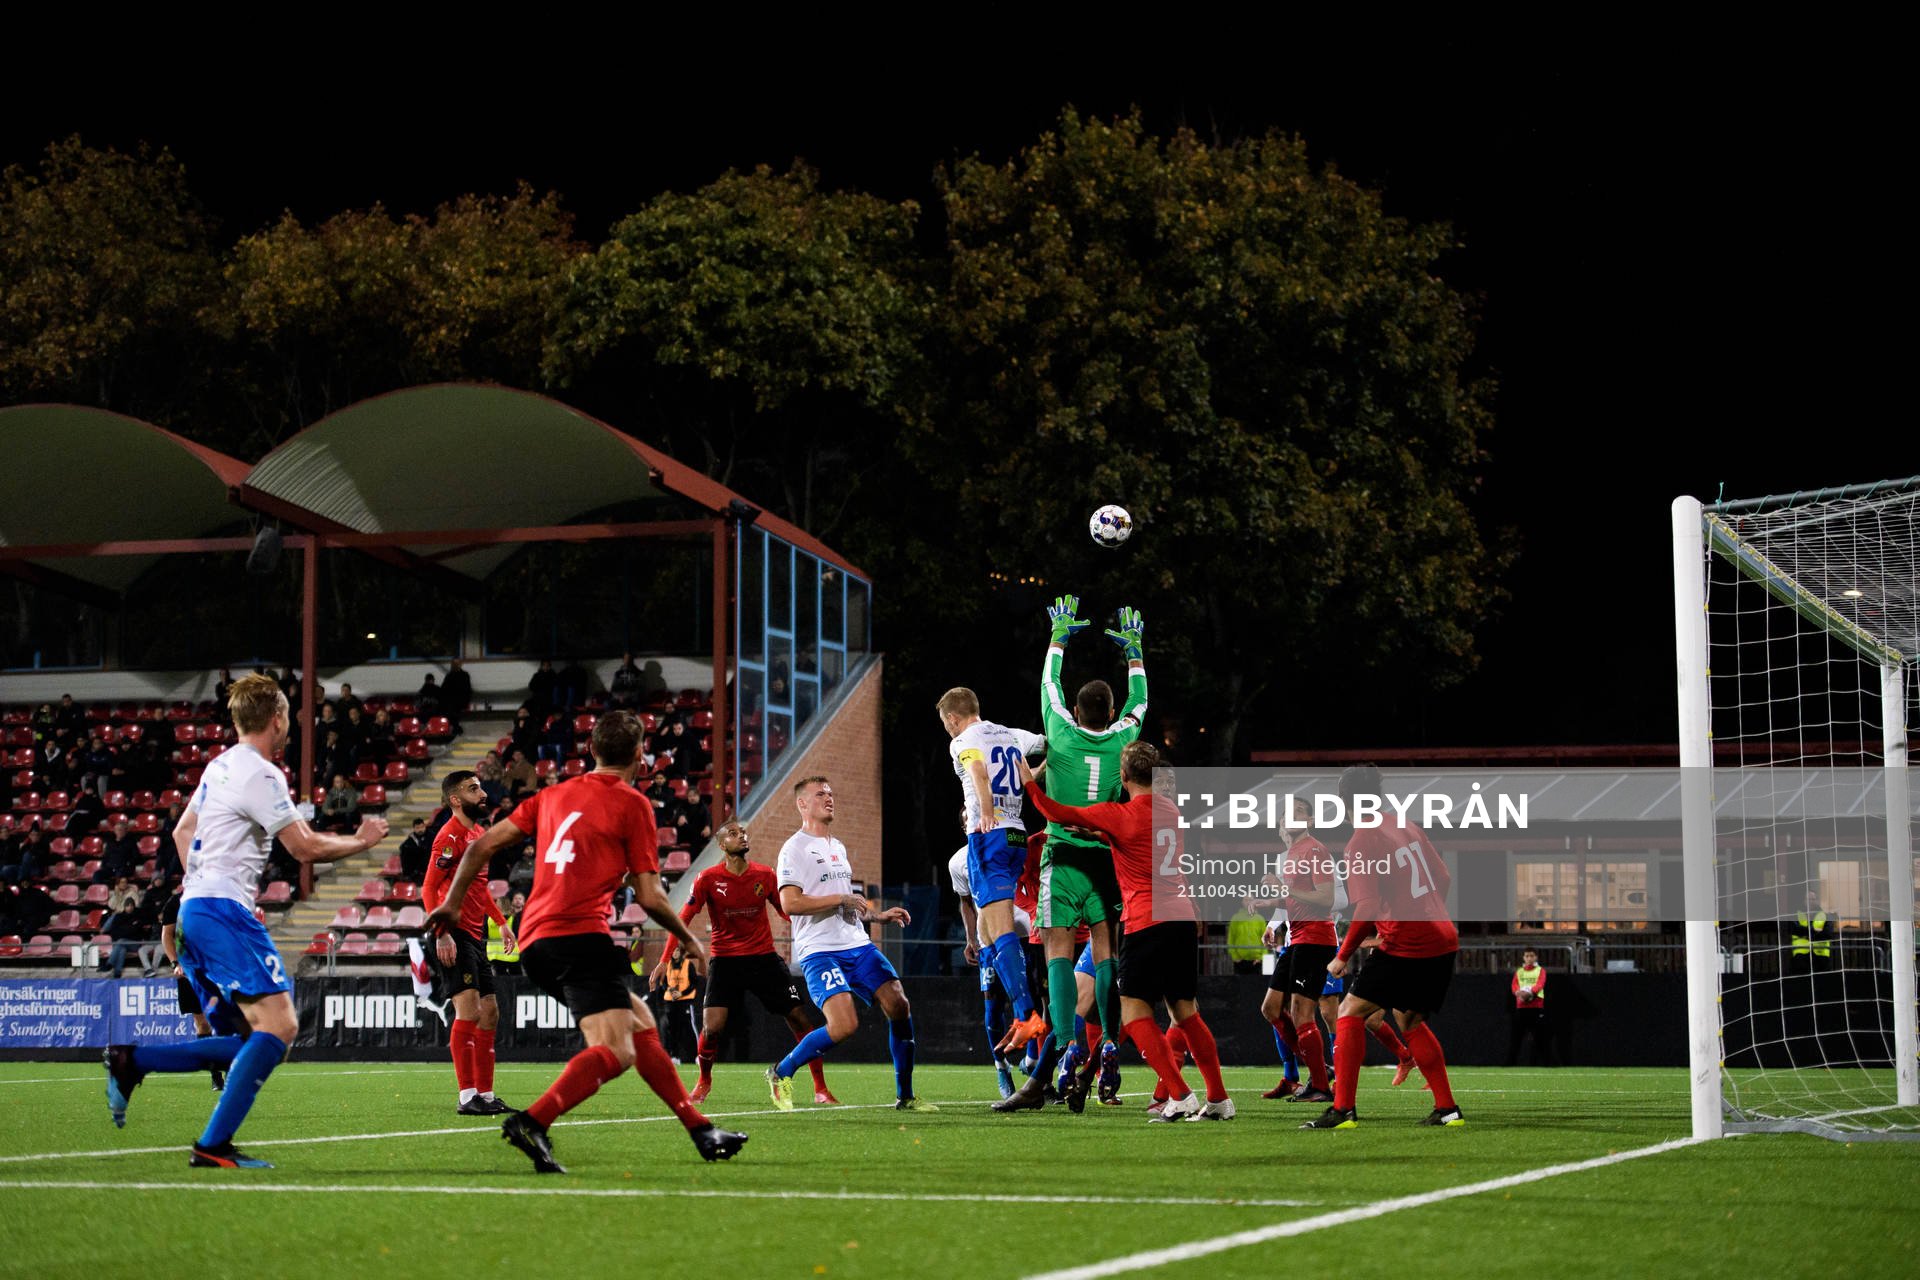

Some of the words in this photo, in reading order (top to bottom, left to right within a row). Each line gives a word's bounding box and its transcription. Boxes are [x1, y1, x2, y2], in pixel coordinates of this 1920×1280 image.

[991, 746, 1022, 796] 20
[1084, 755, 1100, 800] 1
[544, 811, 583, 875] 4
[1156, 828, 1178, 876] 2
[1394, 841, 1436, 899] 21
[265, 955, 285, 984] 2
[821, 967, 845, 991] 25
[8, 1021, 86, 1040] Sundbyberg
[133, 1021, 171, 1036] Solna
[175, 1021, 187, 1036] &
[324, 996, 416, 1028] PUMA
